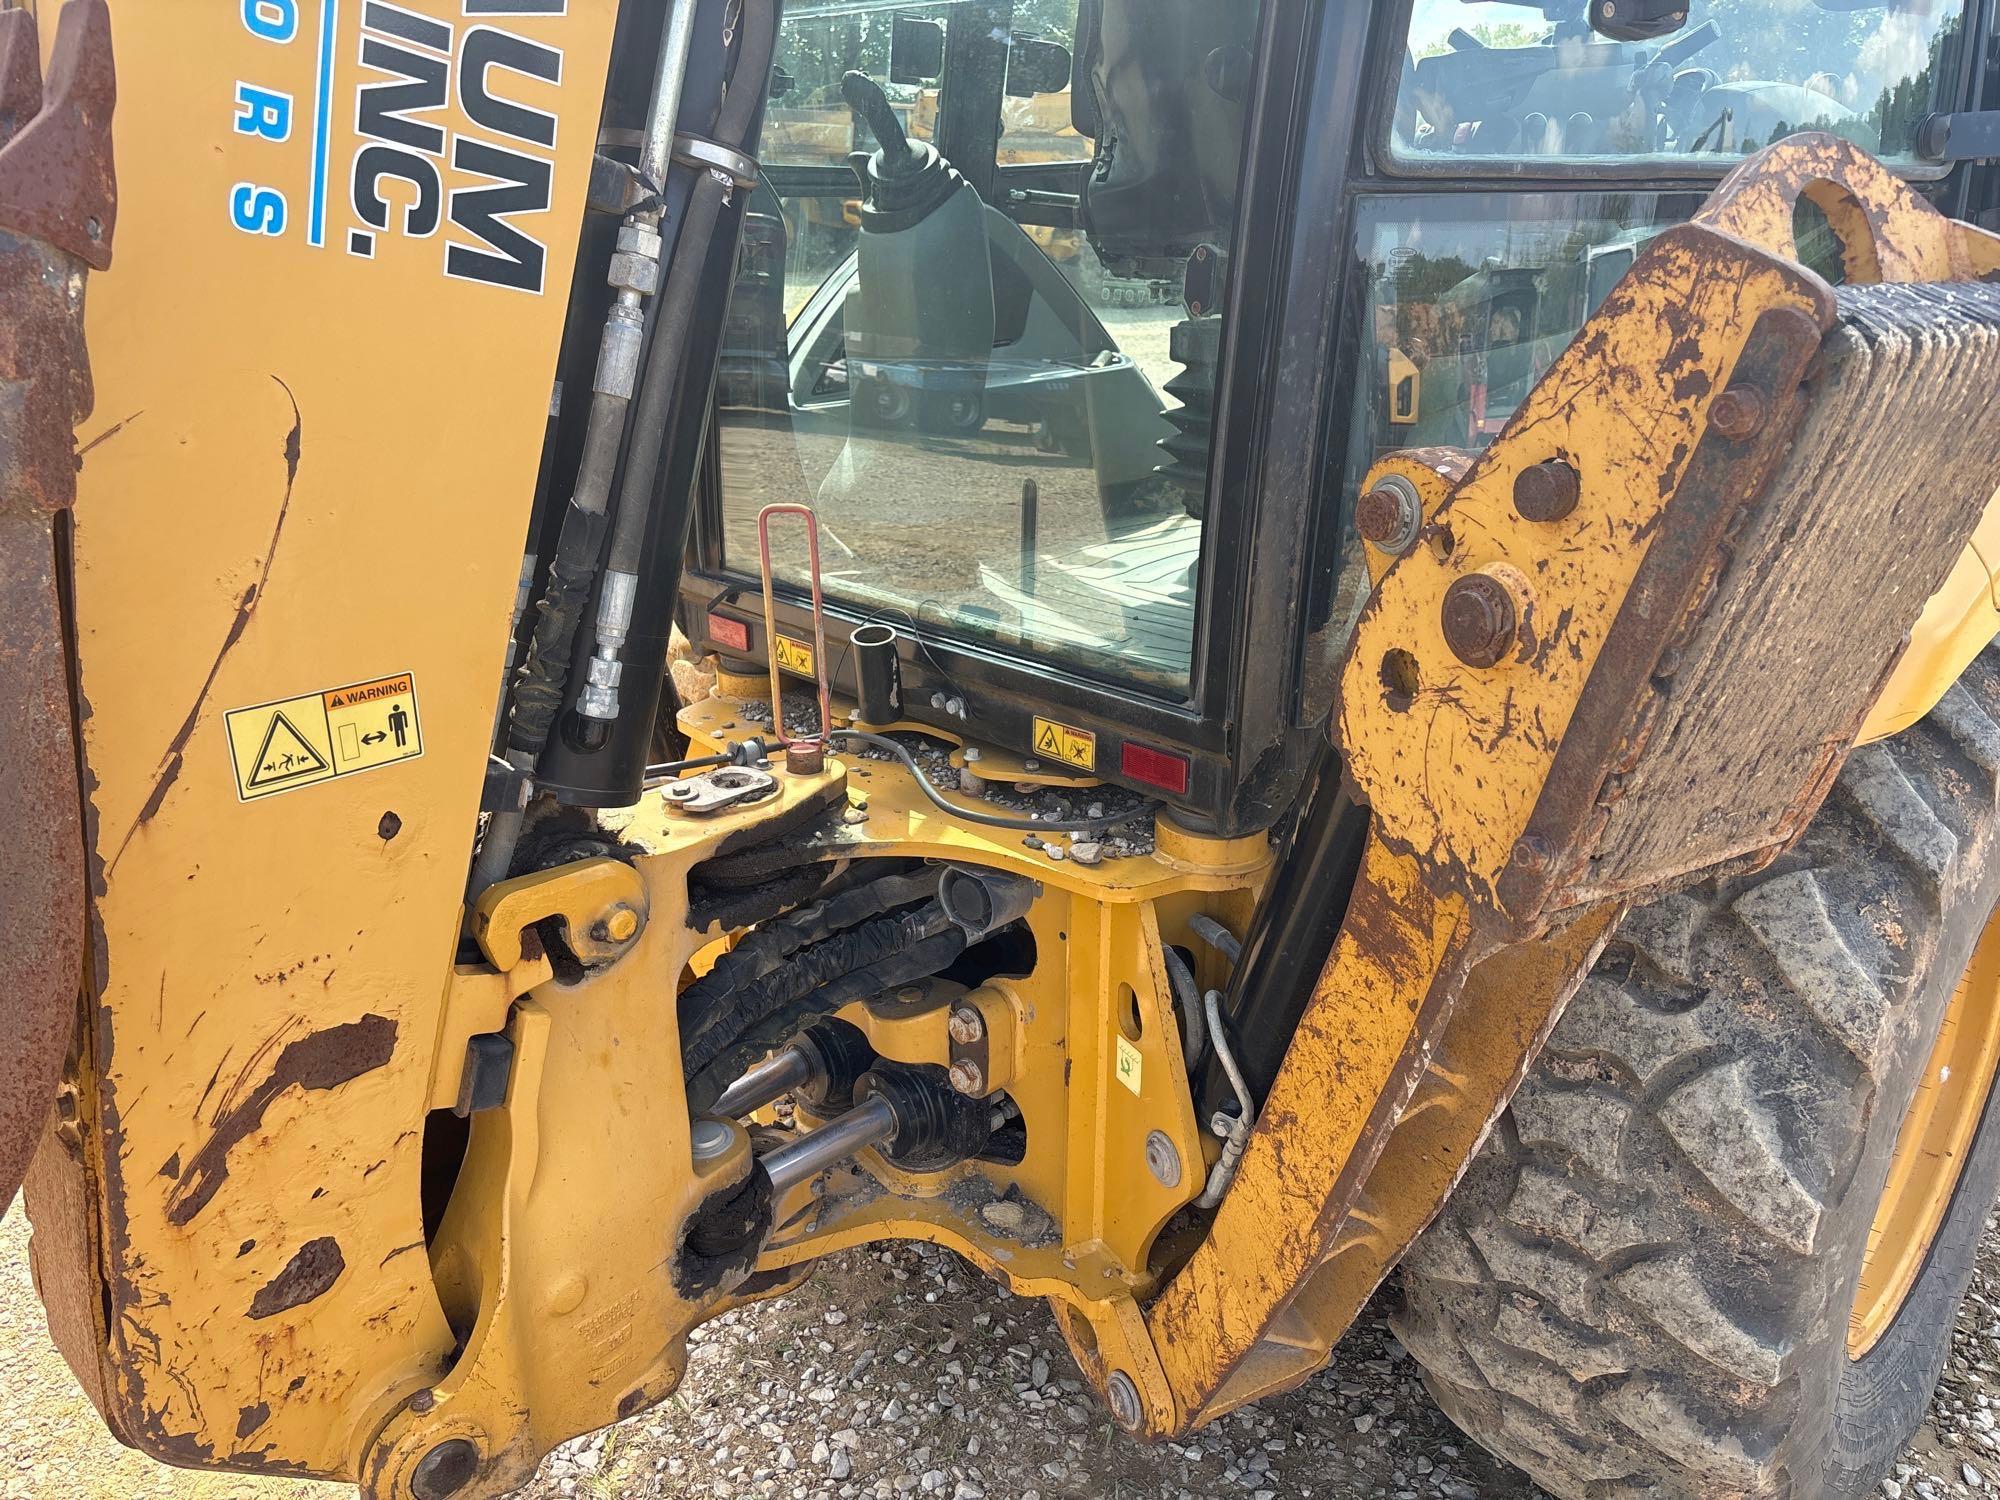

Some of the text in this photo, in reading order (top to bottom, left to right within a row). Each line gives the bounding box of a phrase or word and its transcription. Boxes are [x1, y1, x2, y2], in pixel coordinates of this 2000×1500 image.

[229, 0, 299, 238] ORS
[347, 0, 455, 260] INC.
[443, 0, 568, 296] UM
[347, 682, 407, 703] WARNING
